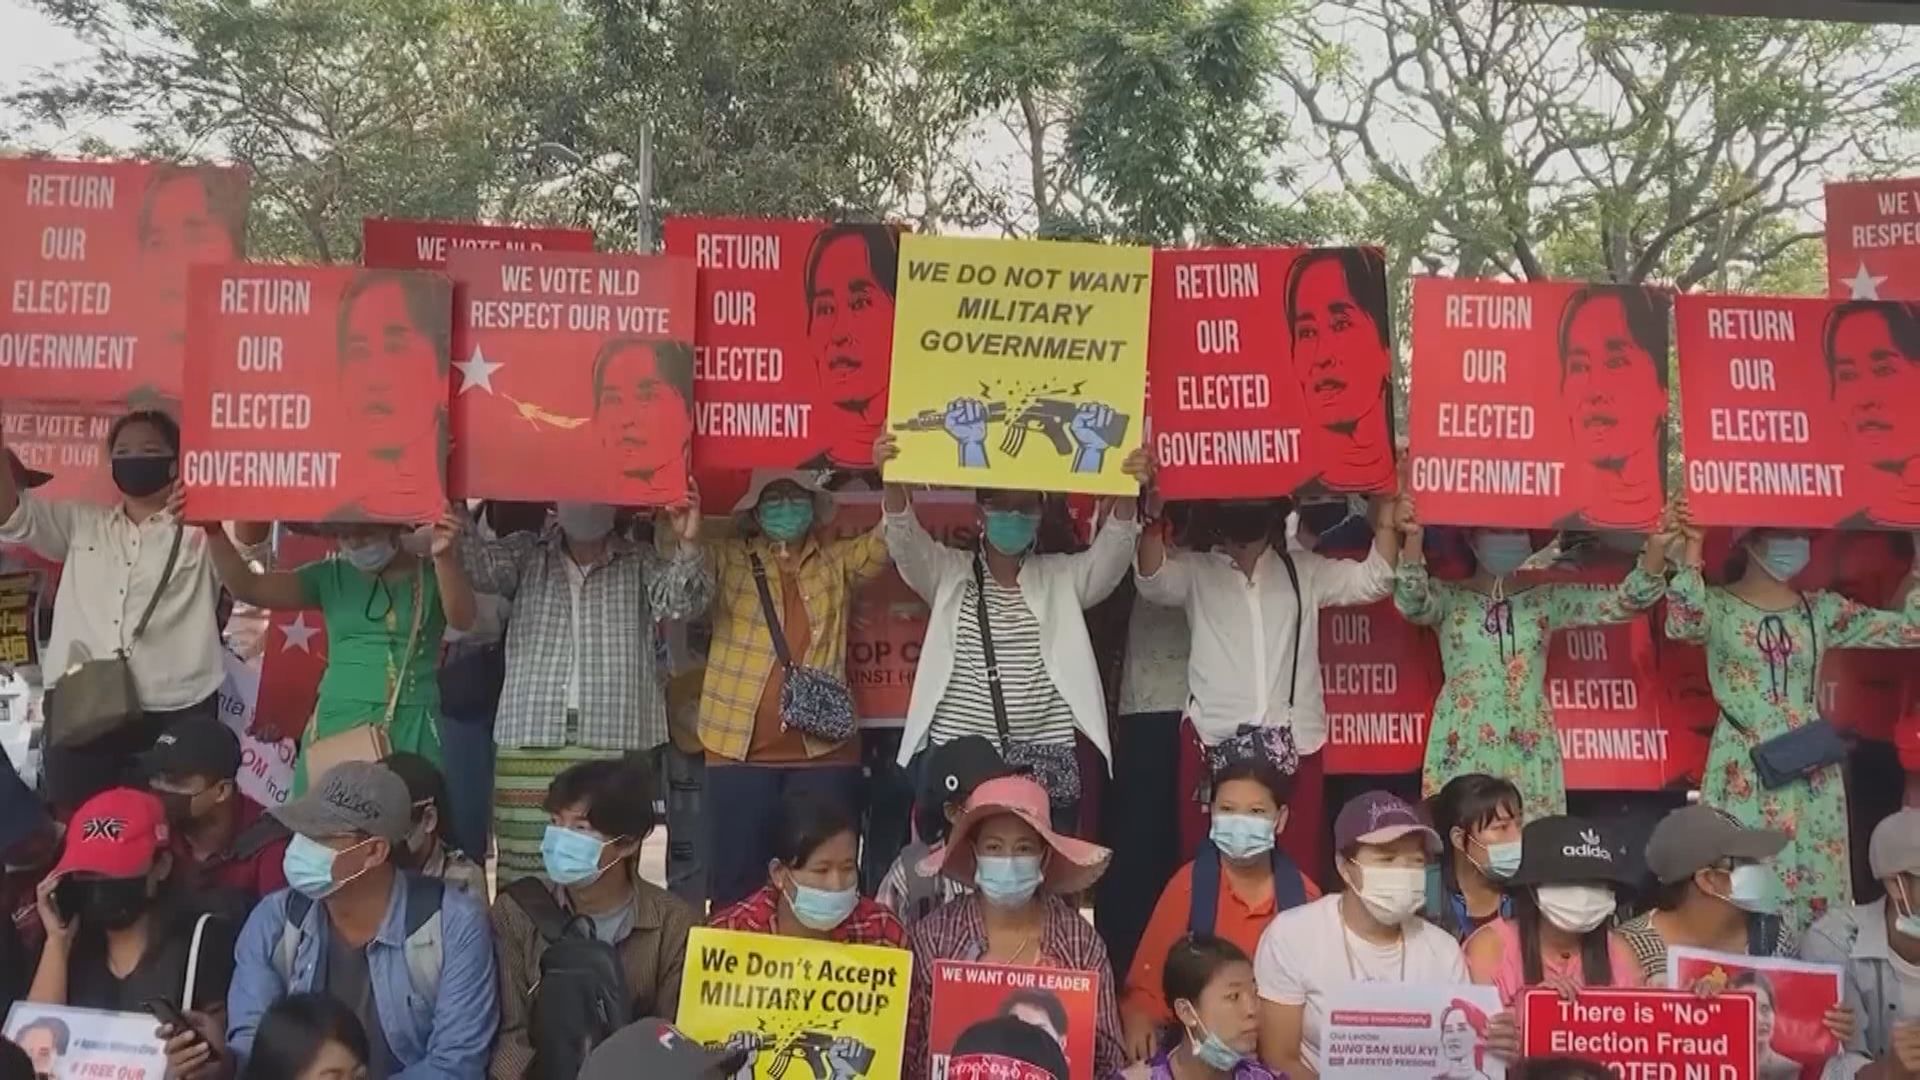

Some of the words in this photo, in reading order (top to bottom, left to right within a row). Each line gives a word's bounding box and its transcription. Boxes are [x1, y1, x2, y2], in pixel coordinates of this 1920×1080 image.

[27, 174, 115, 209] RETURN
[1878, 192, 1909, 215] WE
[40, 227, 86, 261] OUR
[417, 236, 447, 261] WE
[696, 233, 780, 271] RETURN
[1852, 222, 1920, 249] RESPE
[501, 265, 533, 293] WE
[539, 267, 593, 294] VOTE
[598, 269, 640, 296] NLD
[908, 260, 950, 283] WE
[956, 264, 997, 286] DO
[1004, 266, 1062, 290] NOT
[1069, 270, 1148, 296] WANT
[1175, 263, 1260, 300] RETURN
[12, 279, 111, 315] ELECTED
[220, 278, 311, 315] RETURN
[713, 291, 756, 327] OUR
[957, 296, 1093, 326] MILITARY
[1445, 294, 1532, 331] RETURN
[471, 301, 564, 330] RESPECT
[568, 304, 610, 332] OUR
[616, 305, 671, 334] VOTE
[1708, 308, 1796, 342] RETURN
[0, 332, 138, 371] OVERNMENT
[237, 336, 283, 372] OUR
[920, 329, 1127, 363] GOVERNMENT
[1195, 320, 1240, 355] OUR
[694, 346, 784, 383] ELECTED
[1462, 350, 1507, 384] OUR
[1729, 358, 1776, 392] OUR
[1177, 373, 1270, 411] ELECTED
[36, 415, 85, 437] VOTE
[211, 392, 312, 430] ELECTED
[695, 401, 812, 439] VERNMENT
[1438, 402, 1534, 440] ELECTED
[1711, 407, 1810, 444] ELECTED
[1157, 427, 1301, 469] GOVERNMENT
[183, 450, 341, 488] GOVERNMENT
[1411, 457, 1565, 497] GOVERNMENT
[1689, 459, 1845, 497] GOVERNMENT
[1332, 614, 1370, 645] OUR
[1566, 630, 1608, 661] OUR
[852, 642, 891, 665] OP
[1324, 664, 1398, 694] LECTED
[1550, 678, 1638, 711] ELECTED
[1328, 712, 1425, 745] ERNMENT
[1557, 728, 1669, 761] VERNMENT
[702, 946, 738, 973] We
[817, 960, 898, 991] Accept
[942, 966, 962, 982] WE
[965, 968, 1003, 985] WANT
[1007, 972, 1035, 987] OUR
[1039, 974, 1091, 991] LEADER
[700, 980, 817, 1011] MILITARY
[822, 990, 889, 1016] COUP
[1557, 1000, 1626, 1023] There
[1633, 1001, 1655, 1024] is
[1661, 1002, 1722, 1025] "No"
[1329, 1044, 1364, 1055] AUNG
[1365, 1045, 1390, 1056] SAN
[1392, 1045, 1418, 1056] SUU
[1550, 1030, 1649, 1054] Election
[1657, 1032, 1728, 1056] Fraud
[81, 1062, 116, 1078] FREE
